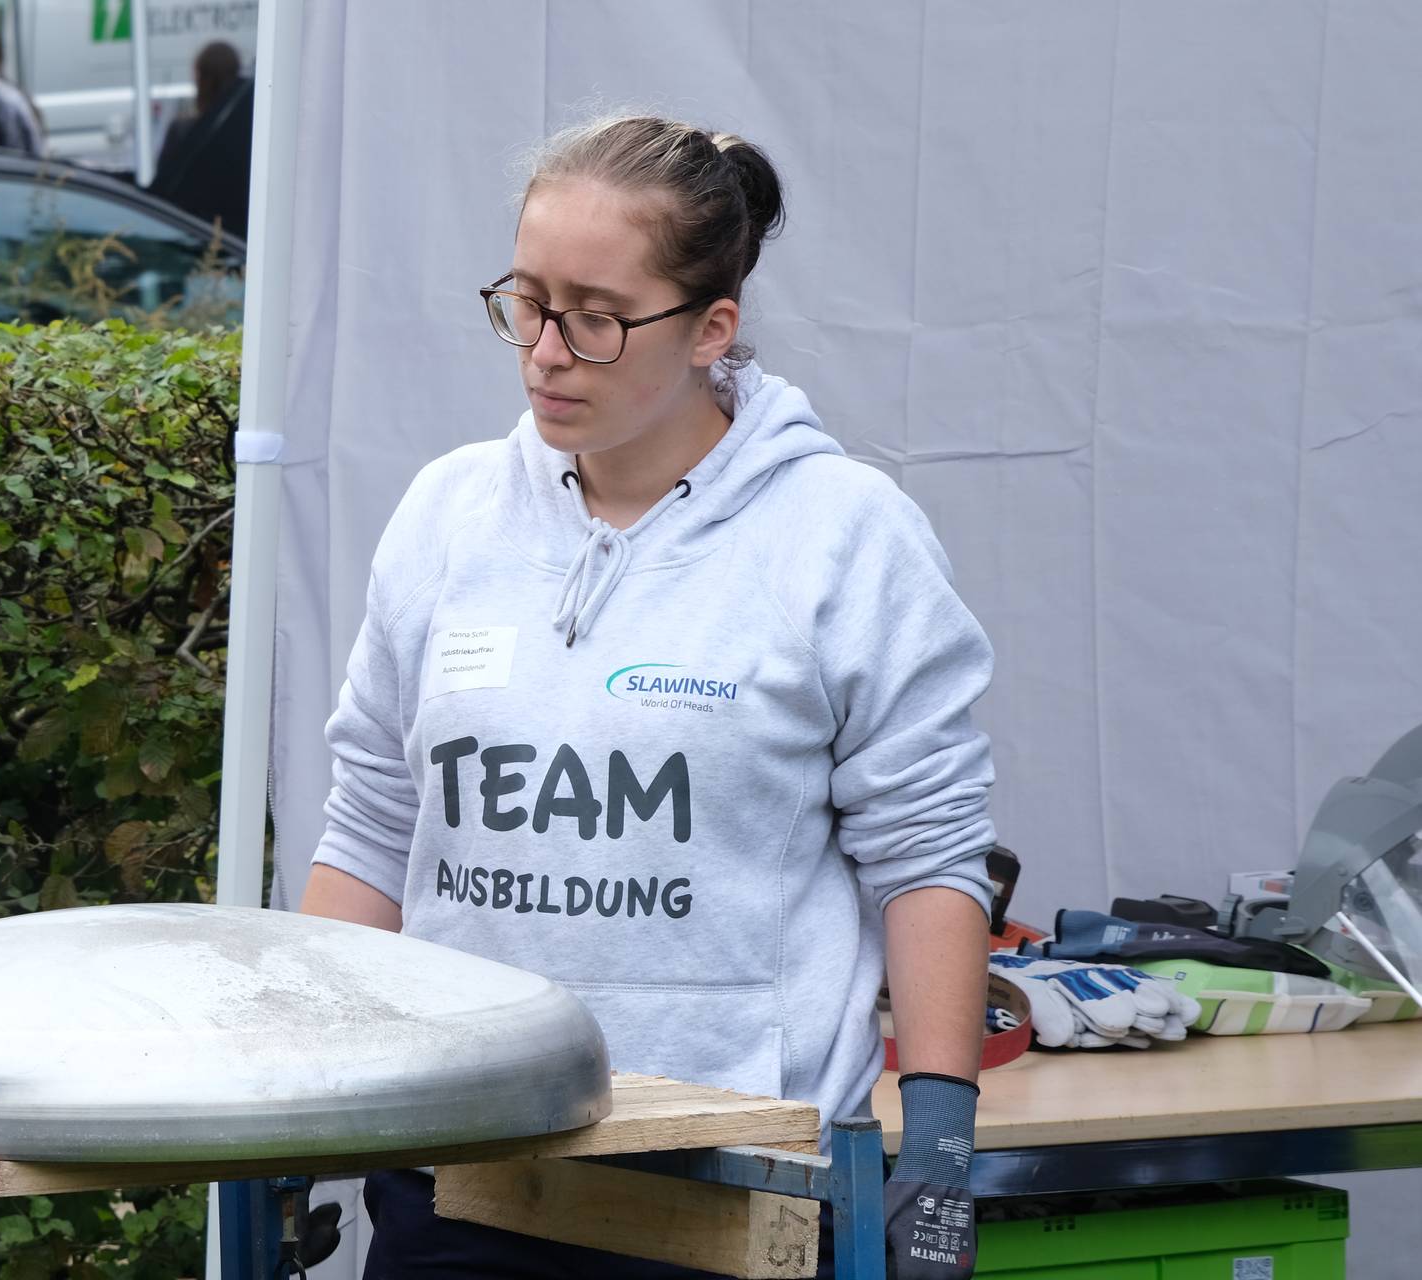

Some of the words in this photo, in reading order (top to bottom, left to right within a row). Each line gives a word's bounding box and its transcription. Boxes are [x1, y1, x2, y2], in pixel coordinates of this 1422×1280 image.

[626, 675, 738, 700] SLAWINSKI
[640, 697, 669, 708] World
[670, 698, 682, 710] Of
[683, 700, 714, 713] Heads
[430, 735, 692, 843] TEAM
[436, 858, 693, 919] AUSBILDUNG
